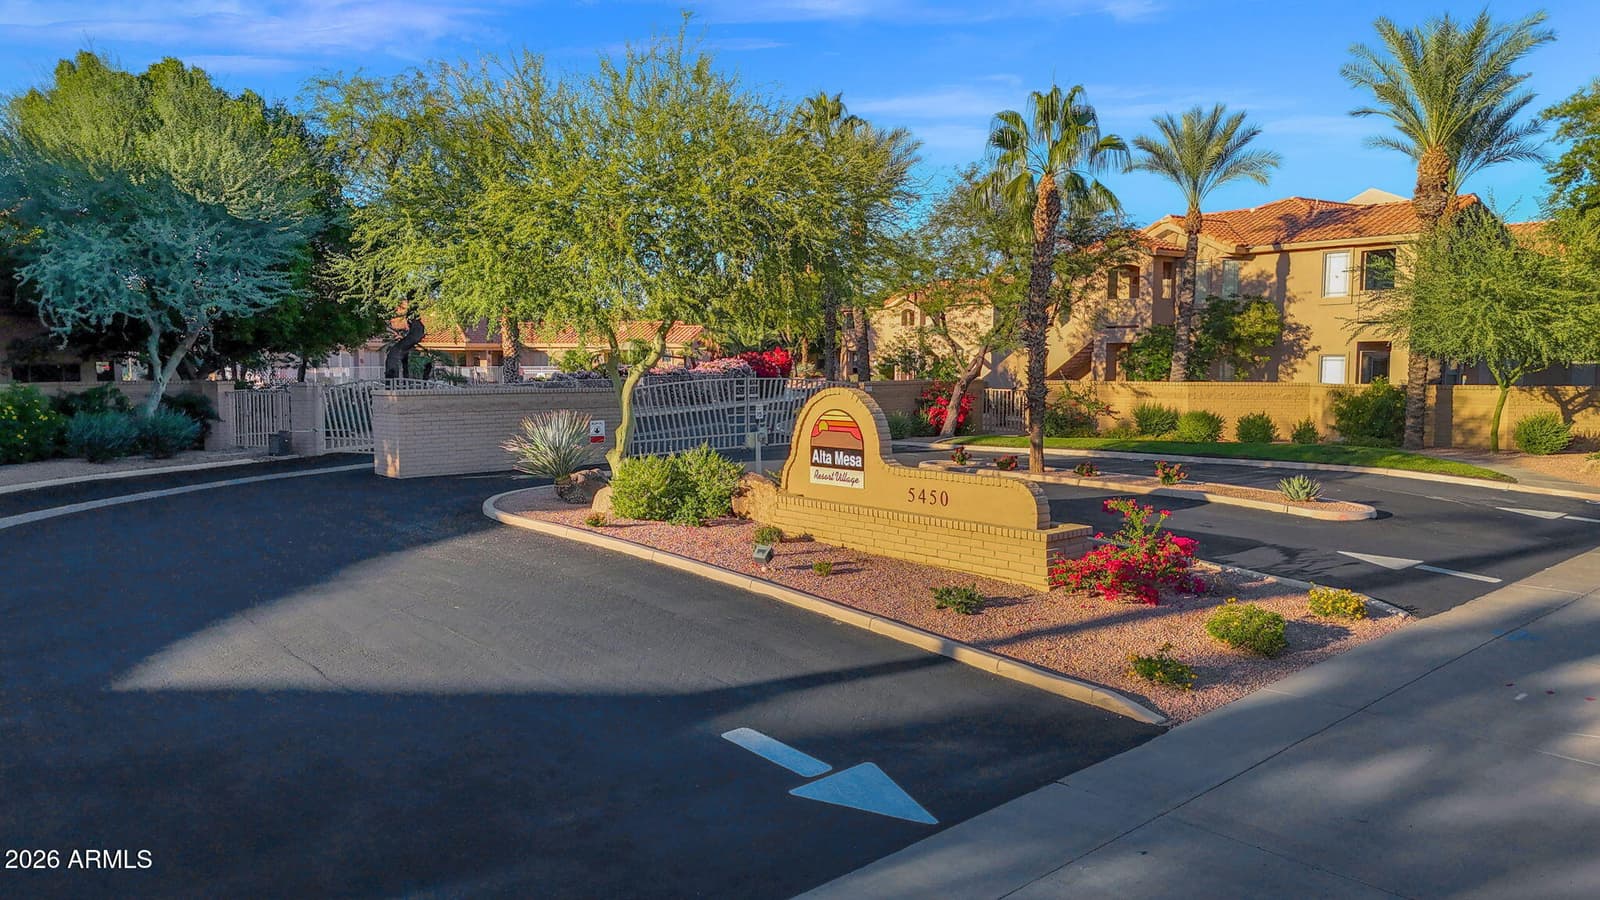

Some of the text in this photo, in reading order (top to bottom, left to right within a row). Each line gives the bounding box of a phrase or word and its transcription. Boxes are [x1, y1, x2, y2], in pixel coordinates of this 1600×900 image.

[812, 449, 862, 467] Alta Mesa
[814, 469, 860, 486] Resort Village
[907, 487, 949, 507] 5450
